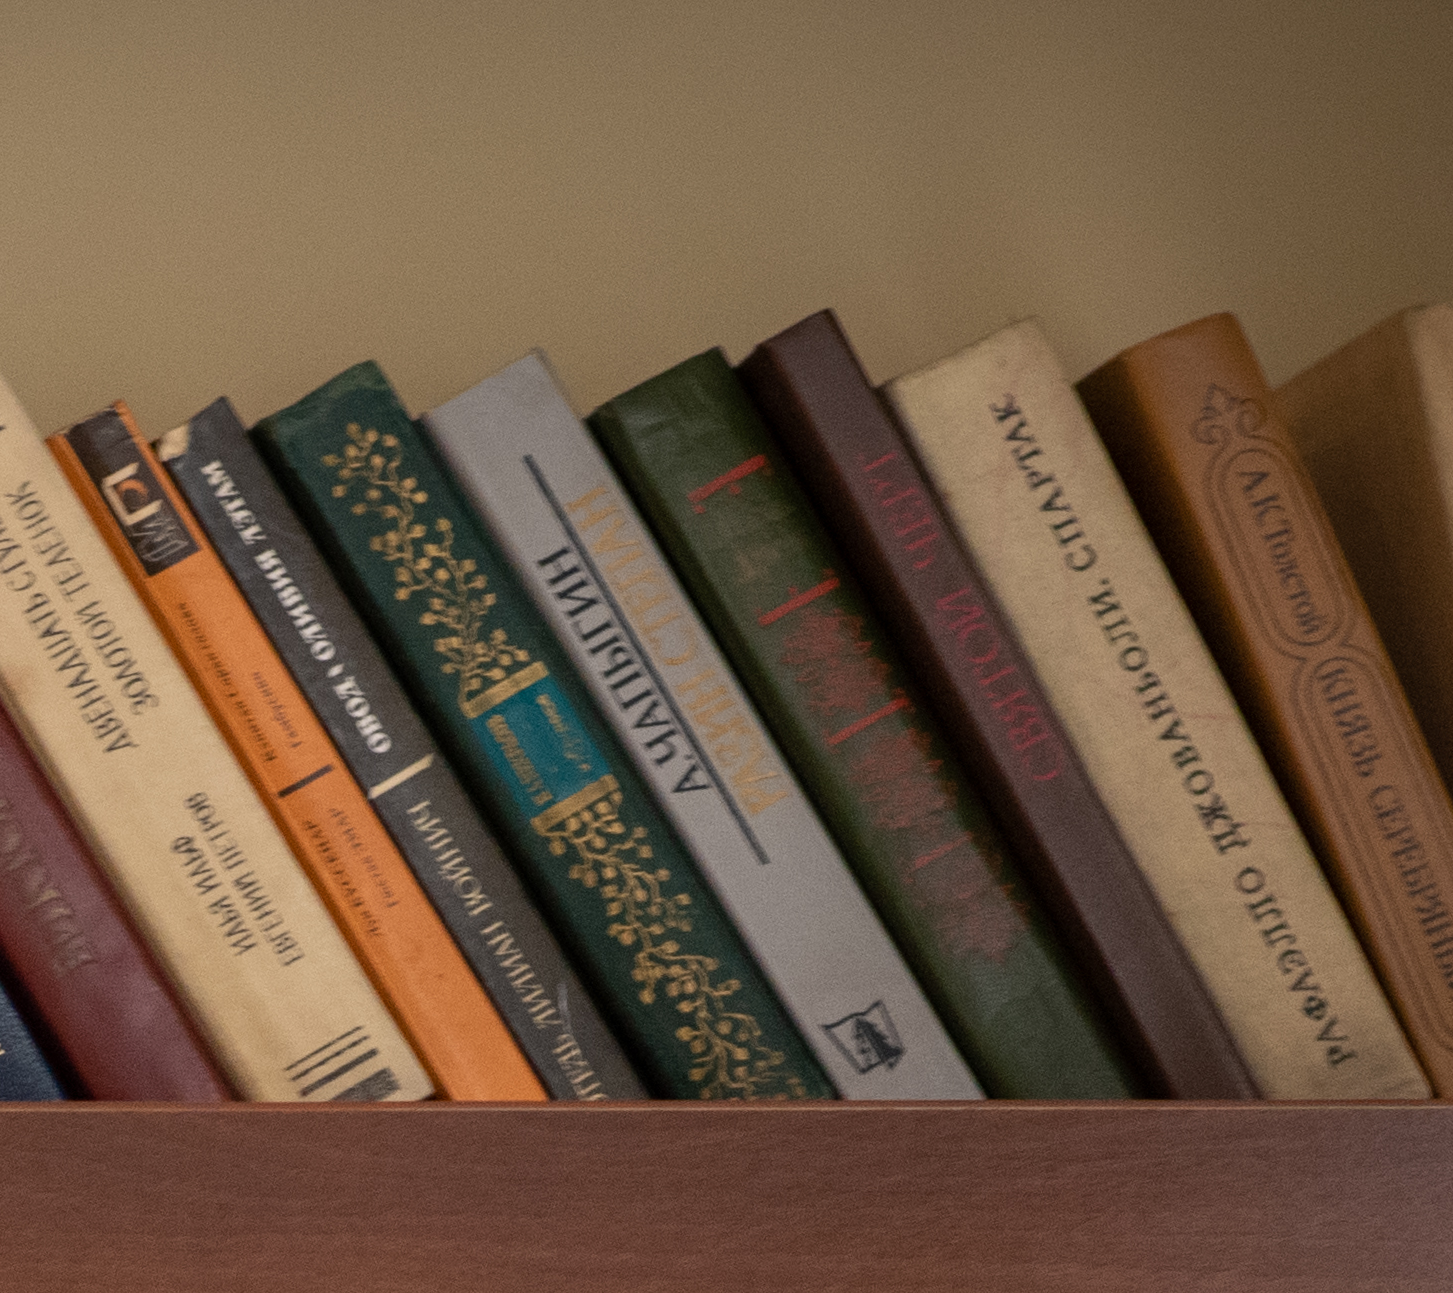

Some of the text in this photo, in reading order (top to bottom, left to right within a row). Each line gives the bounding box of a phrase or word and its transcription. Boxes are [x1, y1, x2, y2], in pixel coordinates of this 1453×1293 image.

[987, 389, 1101, 574] СПАРТАК
[1, 478, 161, 719] ЗОЛОТОЙ ТЕЛЕНОК
[561, 481, 791, 820] РАЗИН СТЕПАН
[1314, 664, 1389, 781] КНЯЗЬ
[167, 831, 259, 959] ИЛЬЯ ИЛЬФ
[181, 787, 307, 968] ЕВГЕНИЙ ПЕТРОВ
[402, 796, 495, 922] ВОЙНИЧ
[1233, 862, 1359, 1070] РАФАЭЛЛО
